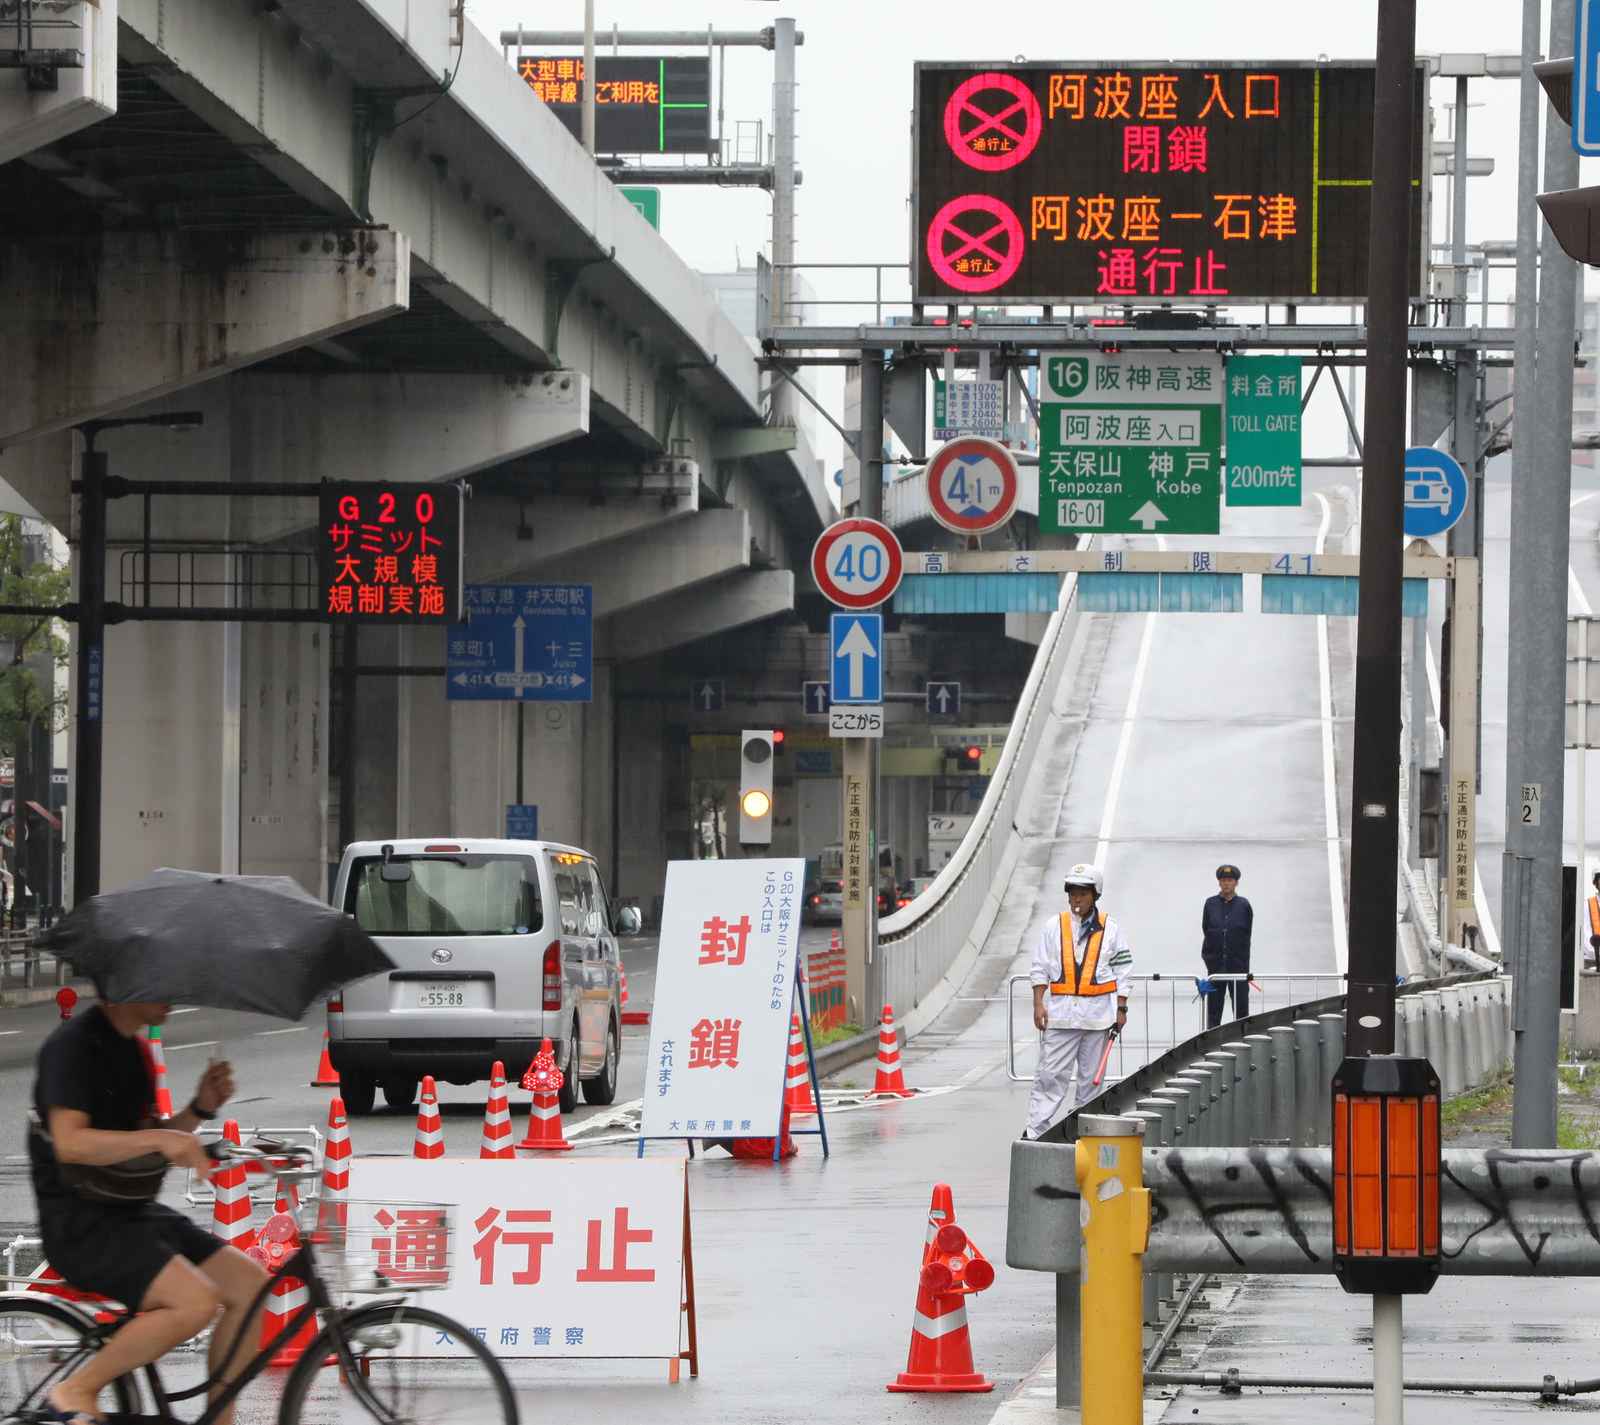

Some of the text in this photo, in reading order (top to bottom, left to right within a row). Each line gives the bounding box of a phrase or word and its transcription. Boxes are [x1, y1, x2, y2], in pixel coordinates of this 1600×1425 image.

[596, 81, 659, 104] ご利用を
[1048, 72, 1280, 120] 阿波座 入口
[973, 137, 1012, 151] 通行止
[1123, 126, 1207, 173] 閉鎖
[956, 259, 994, 273] 通行止
[1097, 247, 1228, 296] 通行止
[1053, 362, 1083, 388] 16
[1095, 364, 1213, 392] 阪神高速
[1231, 375, 1297, 397] 料金所
[1231, 415, 1298, 433] TOLL GATE
[1049, 451, 1211, 479] 天保山 神戸
[1230, 465, 1297, 488] 200m先
[1048, 479, 1202, 496] Tenpozan Kobe
[1060, 502, 1103, 525] 16-01
[328, 523, 442, 553] サミット
[335, 554, 437, 583] 大規模
[834, 544, 882, 582] 40
[328, 585, 445, 614] 規制実施
[465, 588, 584, 605] 大阪港 弁天町駅
[546, 641, 583, 657] 十三
[552, 659, 577, 669] Juso
[470, 675, 482, 685] 41
[555, 675, 568, 685] 41
[832, 713, 881, 731] ここから
[1523, 804, 1531, 823] 2
[849, 782, 861, 901] 不正通行防止対策実施
[1456, 780, 1468, 900] 不正通行防止対策実施
[760, 871, 776, 933] この入口は
[771, 871, 794, 1010] G20大阪サミットのため
[429, 993, 463, 1005] 55-88
[657, 1039, 676, 1097] されます
[669, 1120, 751, 1131] 大阪府警察
[371, 1206, 656, 1285] 通行止
